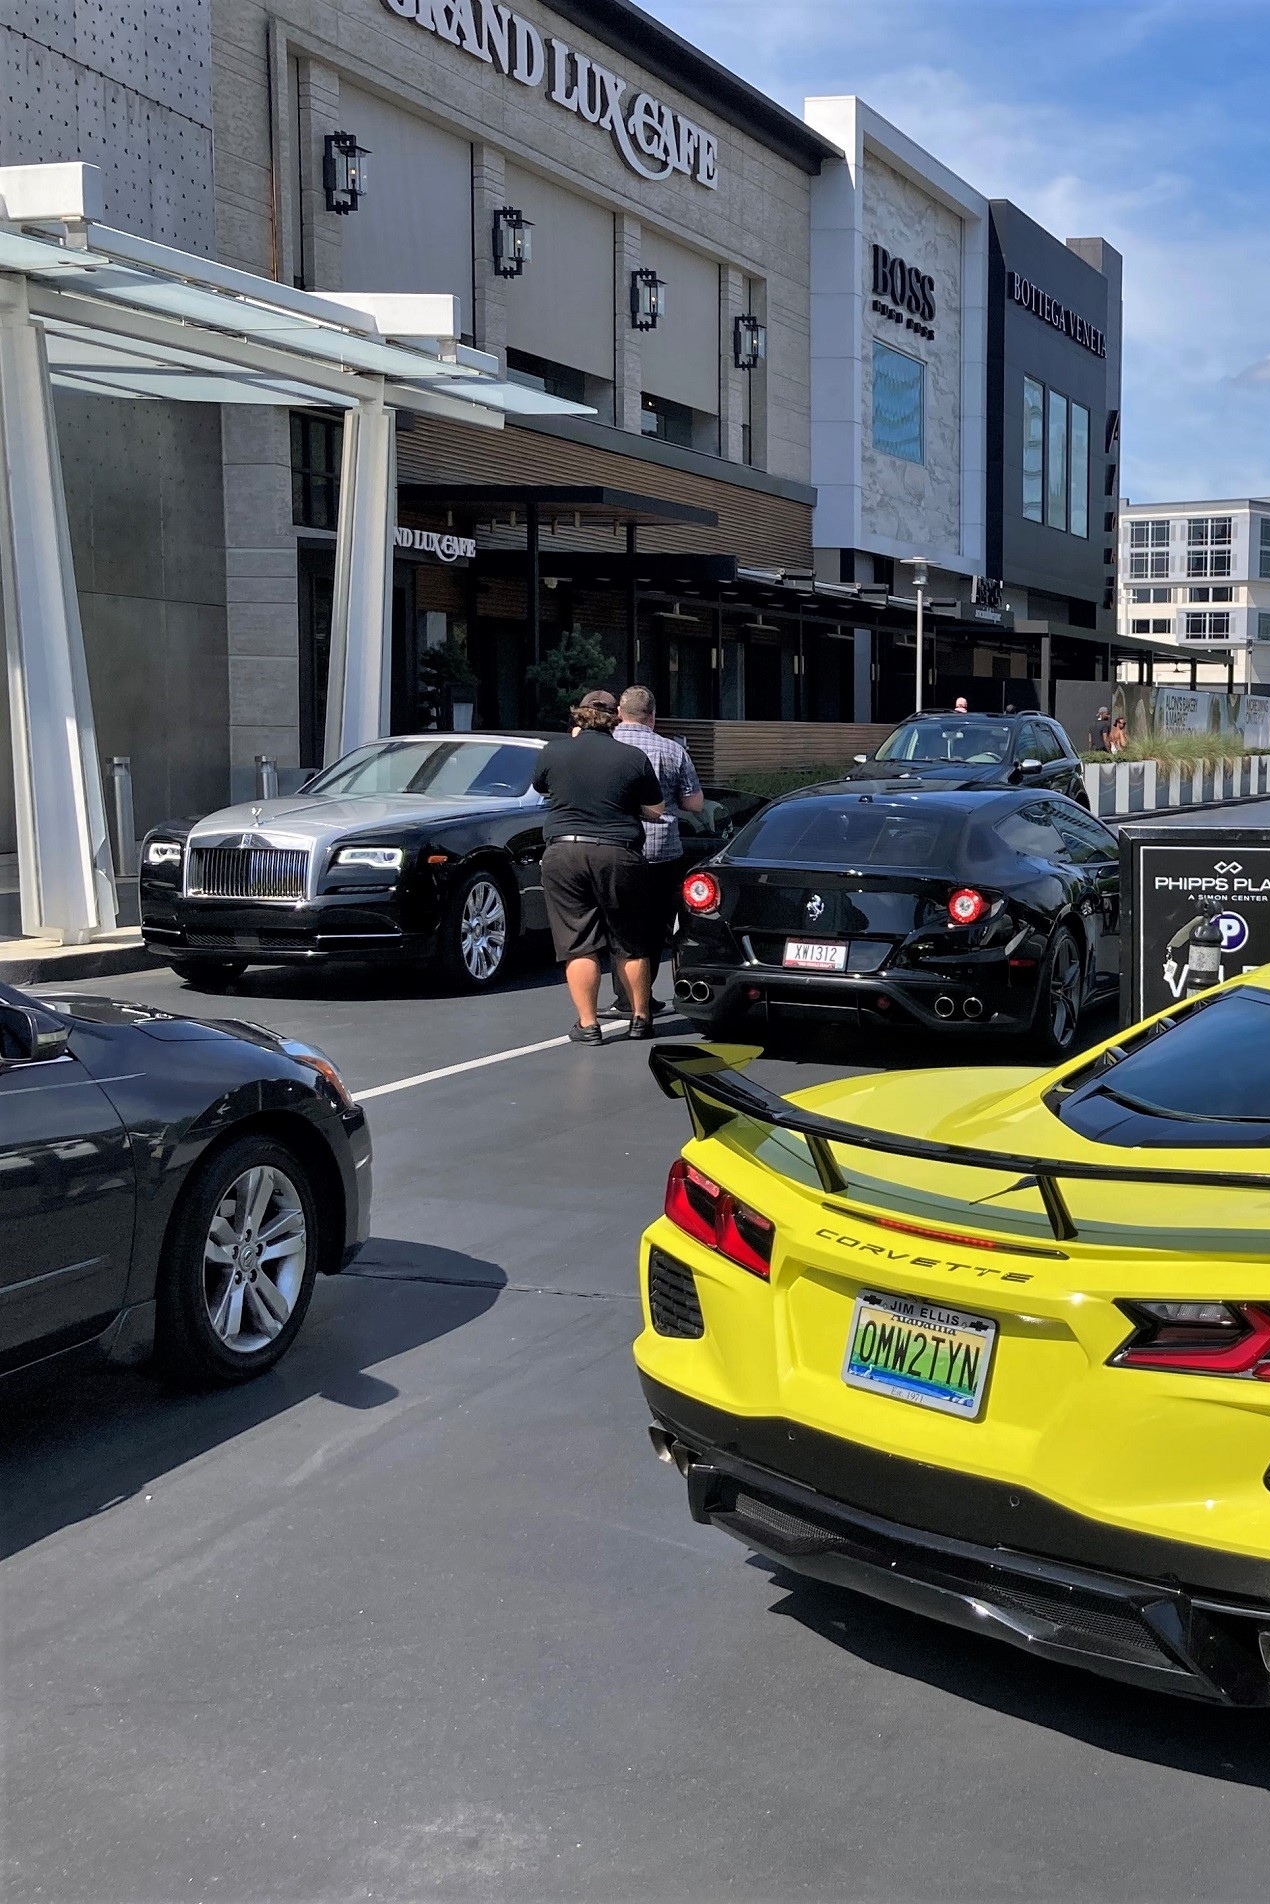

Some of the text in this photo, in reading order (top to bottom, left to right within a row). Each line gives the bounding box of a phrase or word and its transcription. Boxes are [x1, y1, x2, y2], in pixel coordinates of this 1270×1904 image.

[550, 38, 674, 182] LUX
[628, 92, 718, 191] CAFE
[872, 243, 936, 322] BOSS
[1012, 271, 1108, 359] BOTTEGA VENETA
[413, 529, 457, 562] LUX
[441, 534, 476, 558] CAFE
[1155, 876, 1229, 891] PHIPPS
[1220, 918, 1240, 945] P
[815, 1228, 1035, 1283] CORVETTE
[890, 1300, 960, 1326] JIM ELLIS
